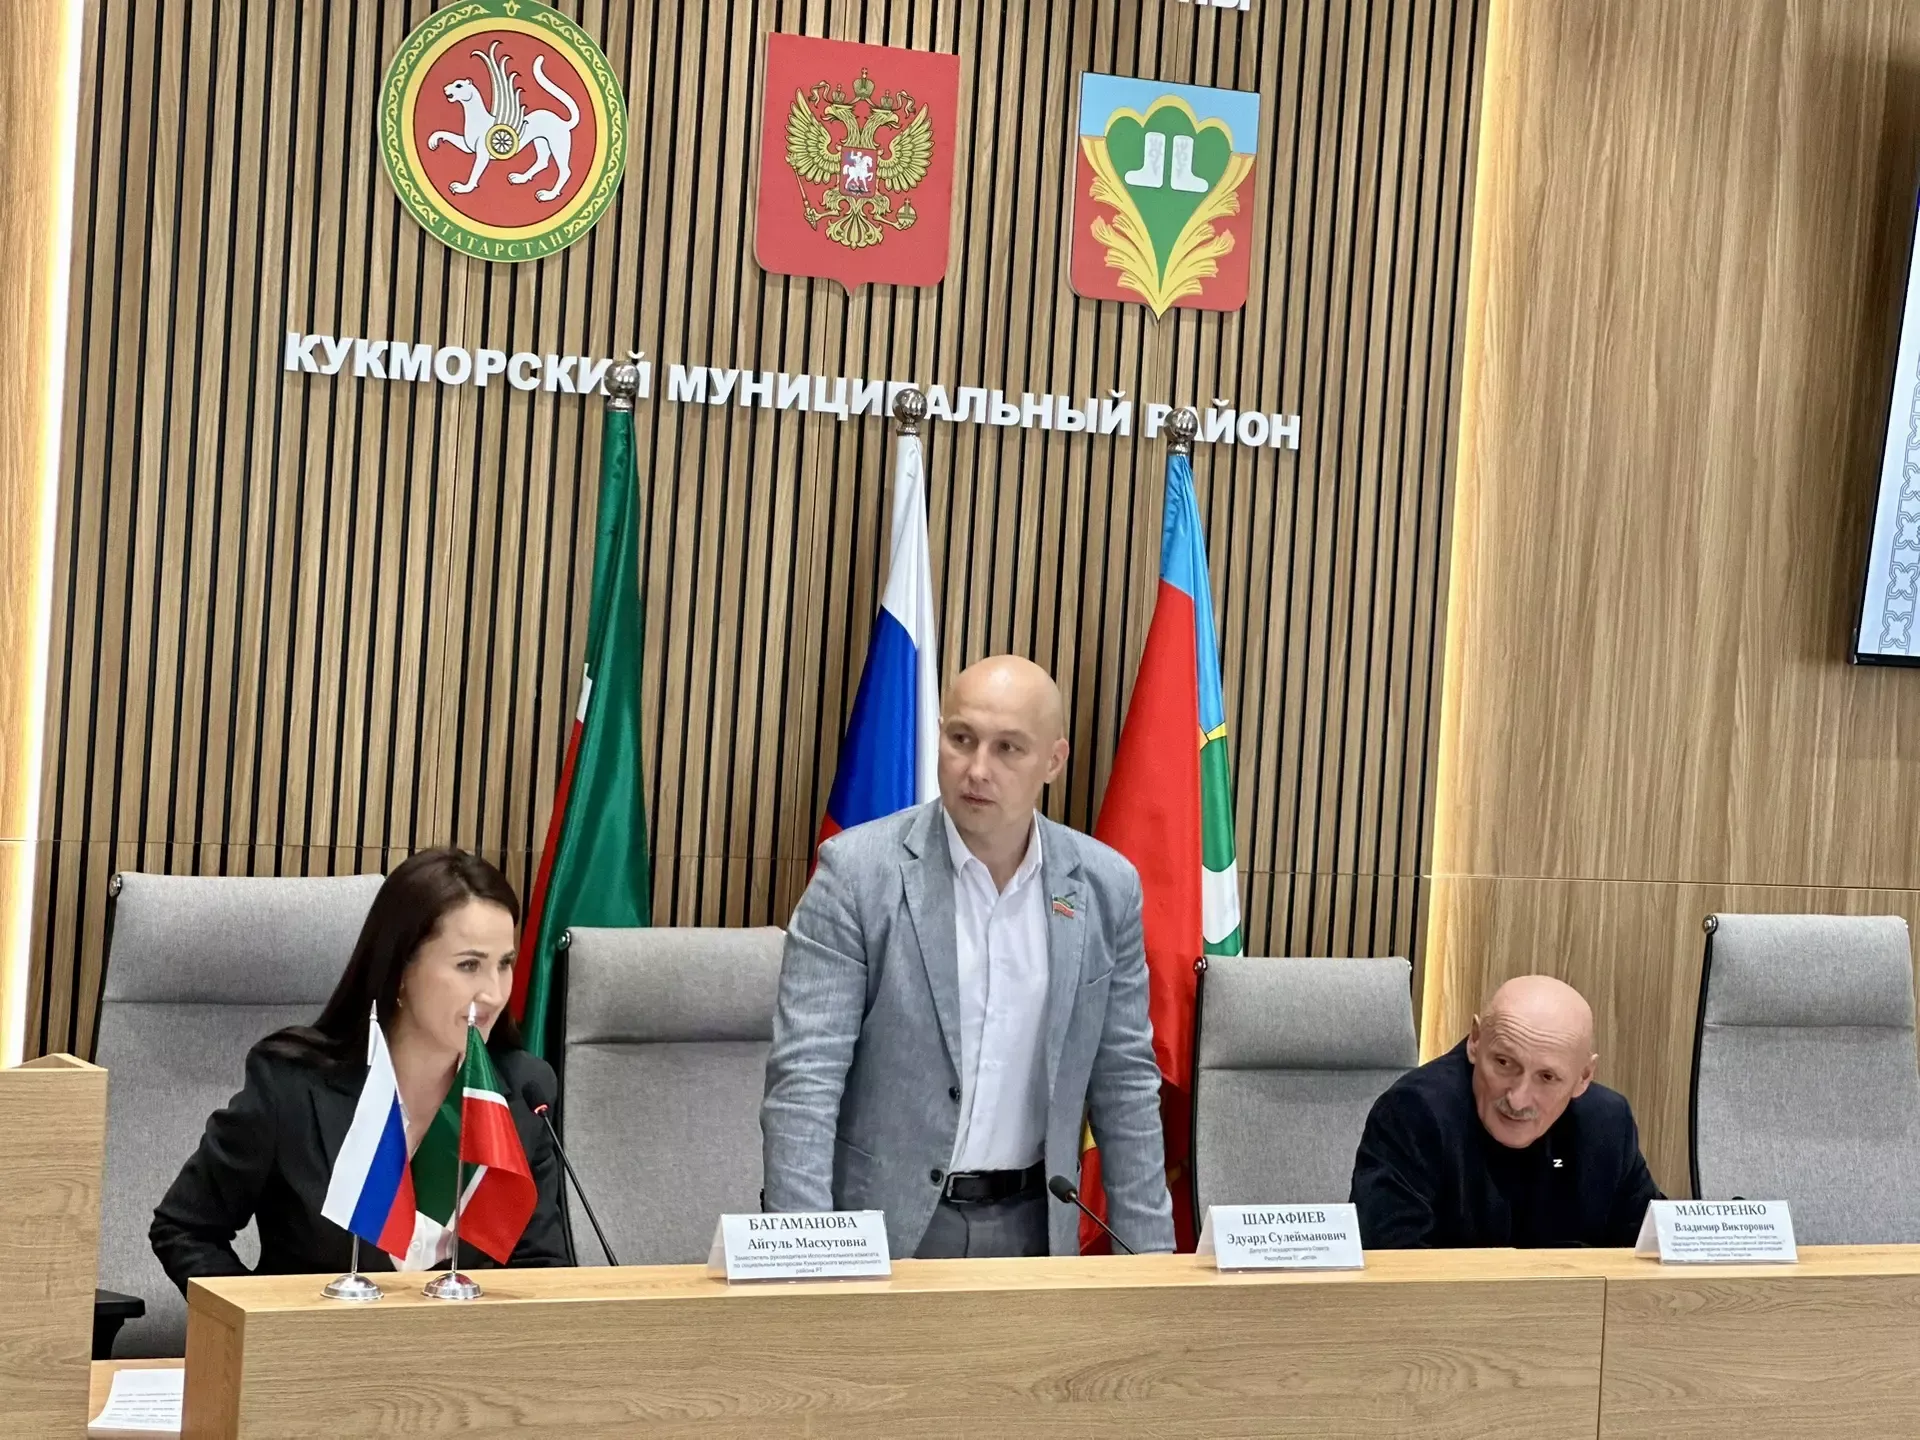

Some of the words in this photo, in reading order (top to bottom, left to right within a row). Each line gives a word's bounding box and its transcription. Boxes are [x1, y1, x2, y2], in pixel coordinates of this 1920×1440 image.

[440, 221, 563, 258] ТАТАРСТАН
[667, 363, 1132, 436] МУНИЦИПАЛЬНЫЙ
[1675, 1202, 1767, 1216] МАЙСТРЕНКО
[749, 1216, 858, 1231] БАГАМАНОВА
[1242, 1211, 1326, 1225] ШАРАФИЕВ
[1674, 1222, 1720, 1233] Владимир
[1721, 1222, 1775, 1233] Викторович
[747, 1237, 793, 1252] Айгуль
[795, 1236, 867, 1251] Масхутовна
[1227, 1233, 1267, 1247] Эдуард
[1268, 1230, 1347, 1245] Сулейманович
